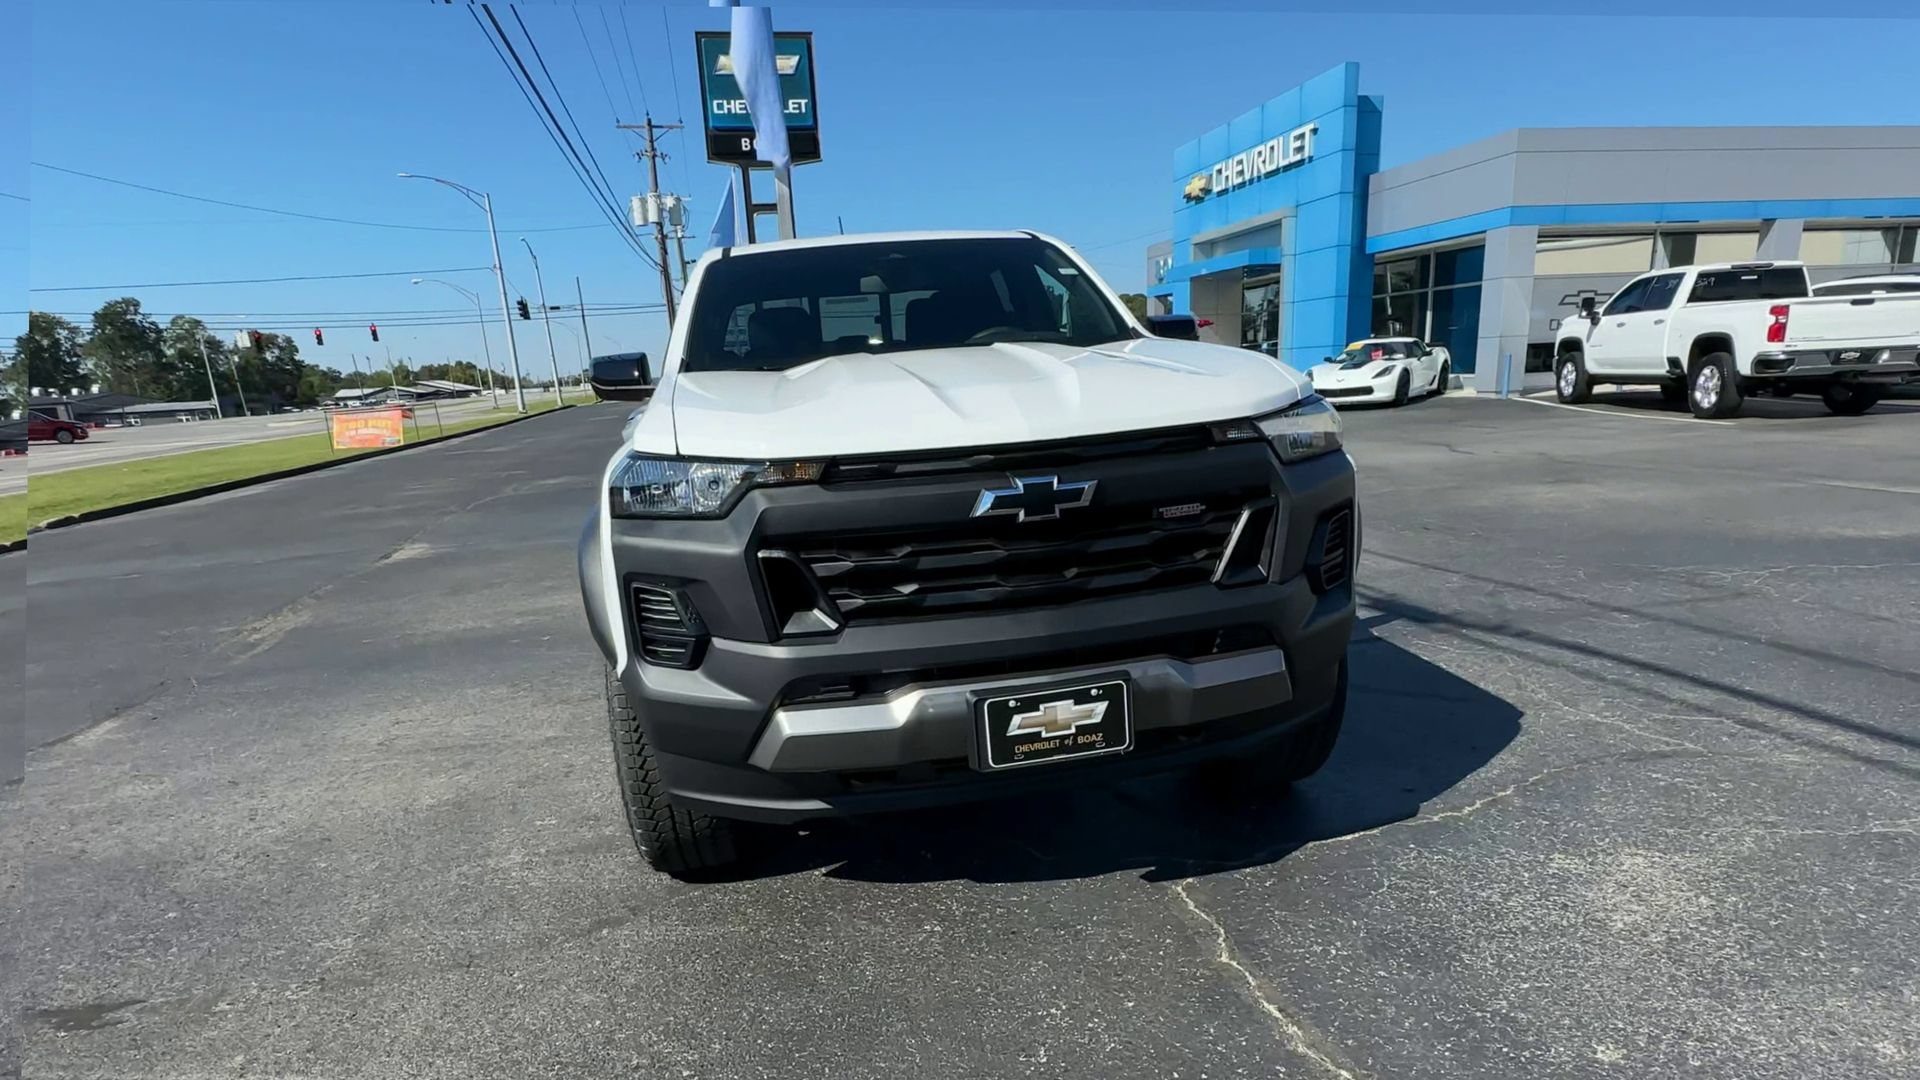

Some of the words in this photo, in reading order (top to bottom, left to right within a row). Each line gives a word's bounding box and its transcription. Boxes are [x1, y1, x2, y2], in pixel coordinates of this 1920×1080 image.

[713, 99, 808, 113] CHEET
[1212, 123, 1317, 193] CHEVROLET
[1015, 740, 1060, 753] CHEVROLET
[1077, 733, 1104, 743] BOAZ
